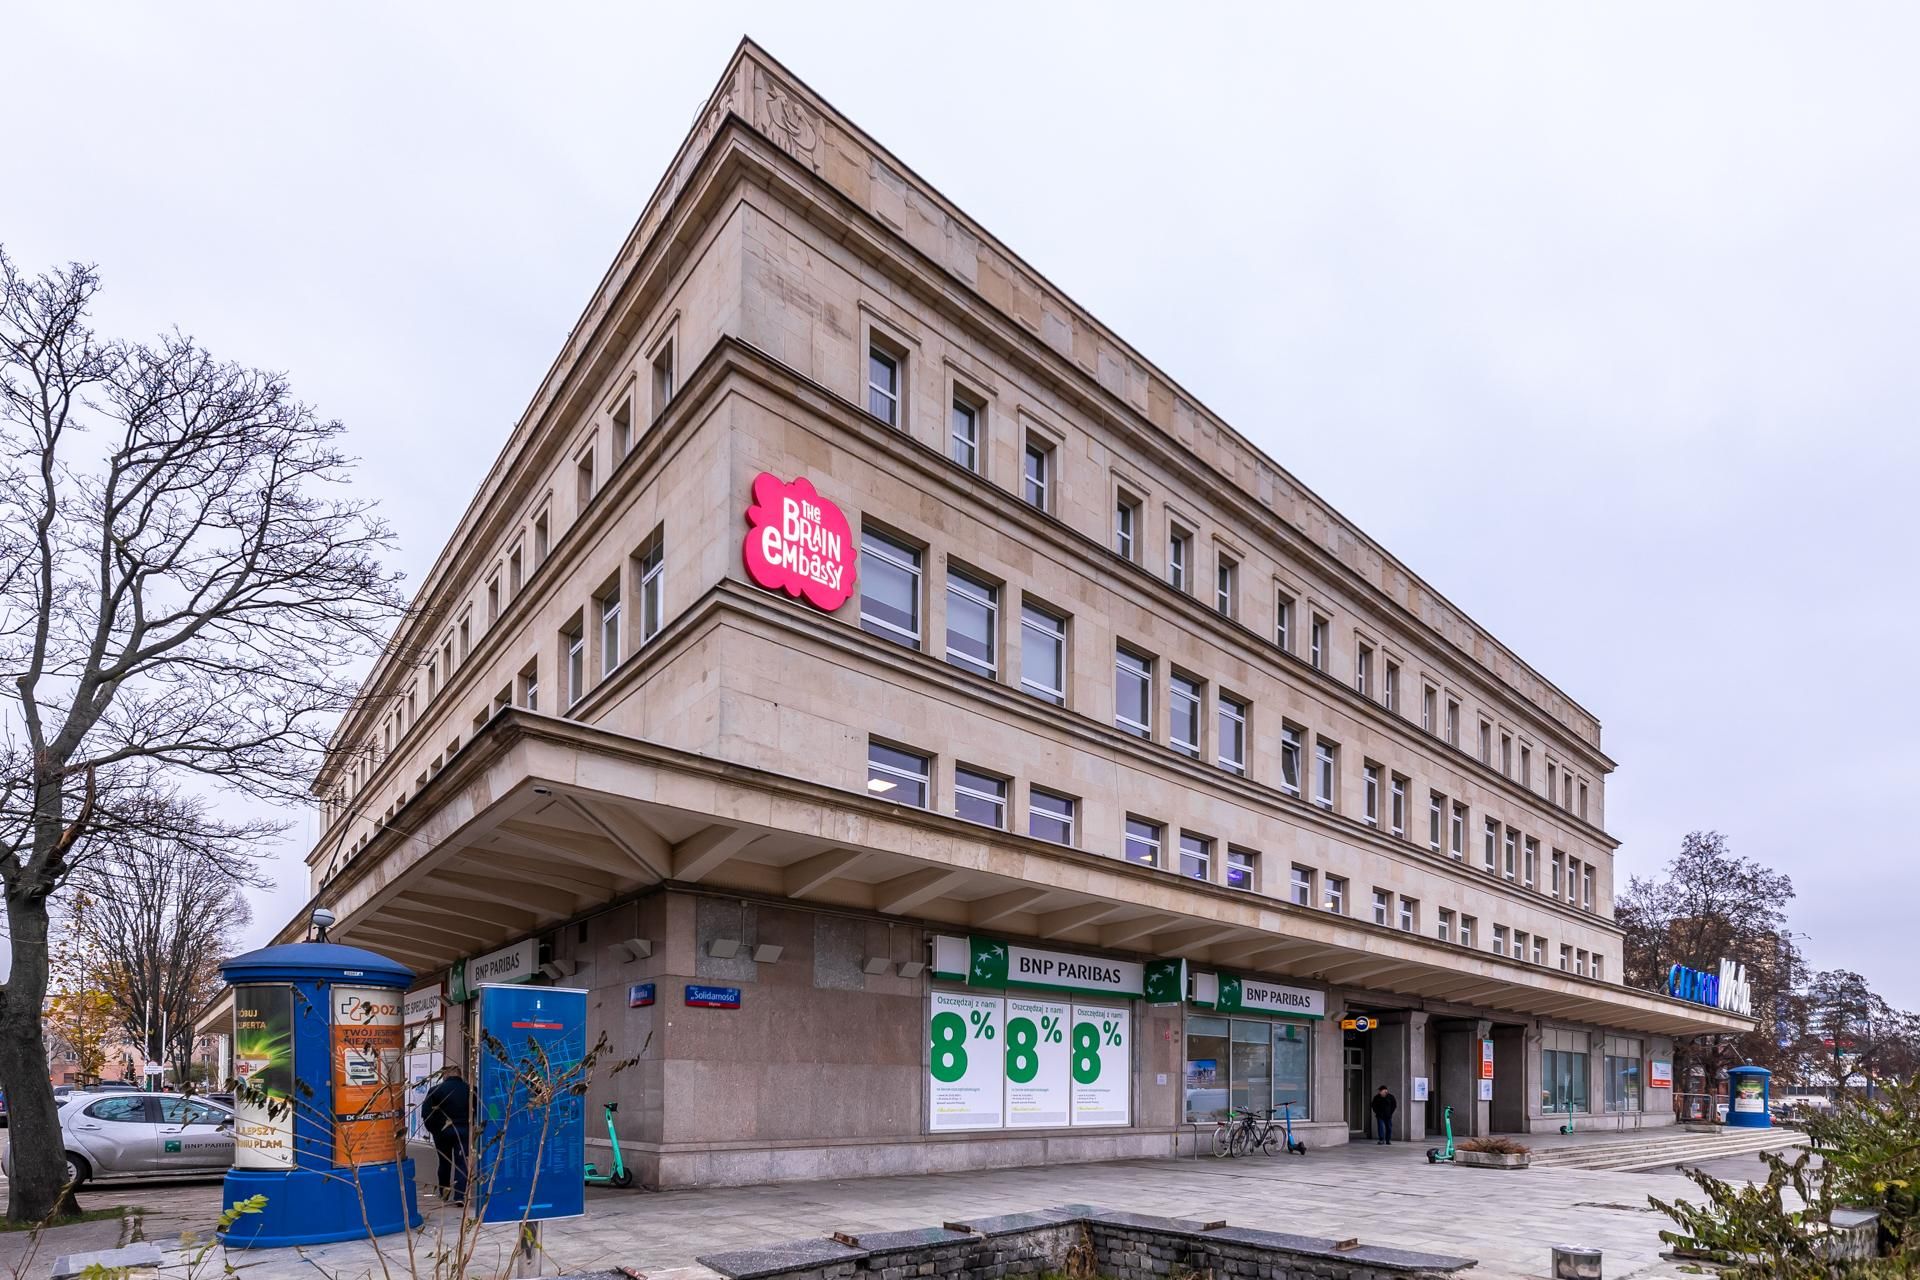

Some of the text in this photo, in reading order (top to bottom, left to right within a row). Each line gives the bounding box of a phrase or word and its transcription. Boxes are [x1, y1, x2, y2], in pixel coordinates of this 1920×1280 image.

[783, 497, 841, 562] BRAIN
[475, 952, 520, 981] BNP PARIBAS
[1020, 957, 1121, 984] BNP PARIBAS
[937, 996, 974, 1008] Oszczędzaj
[1246, 988, 1311, 1008] BNP PARIBAS
[1012, 1003, 1044, 1014] Oszczędzaj
[1077, 1009, 1106, 1019] Oszczędzaj
[254, 1140, 283, 1149] PLAM
